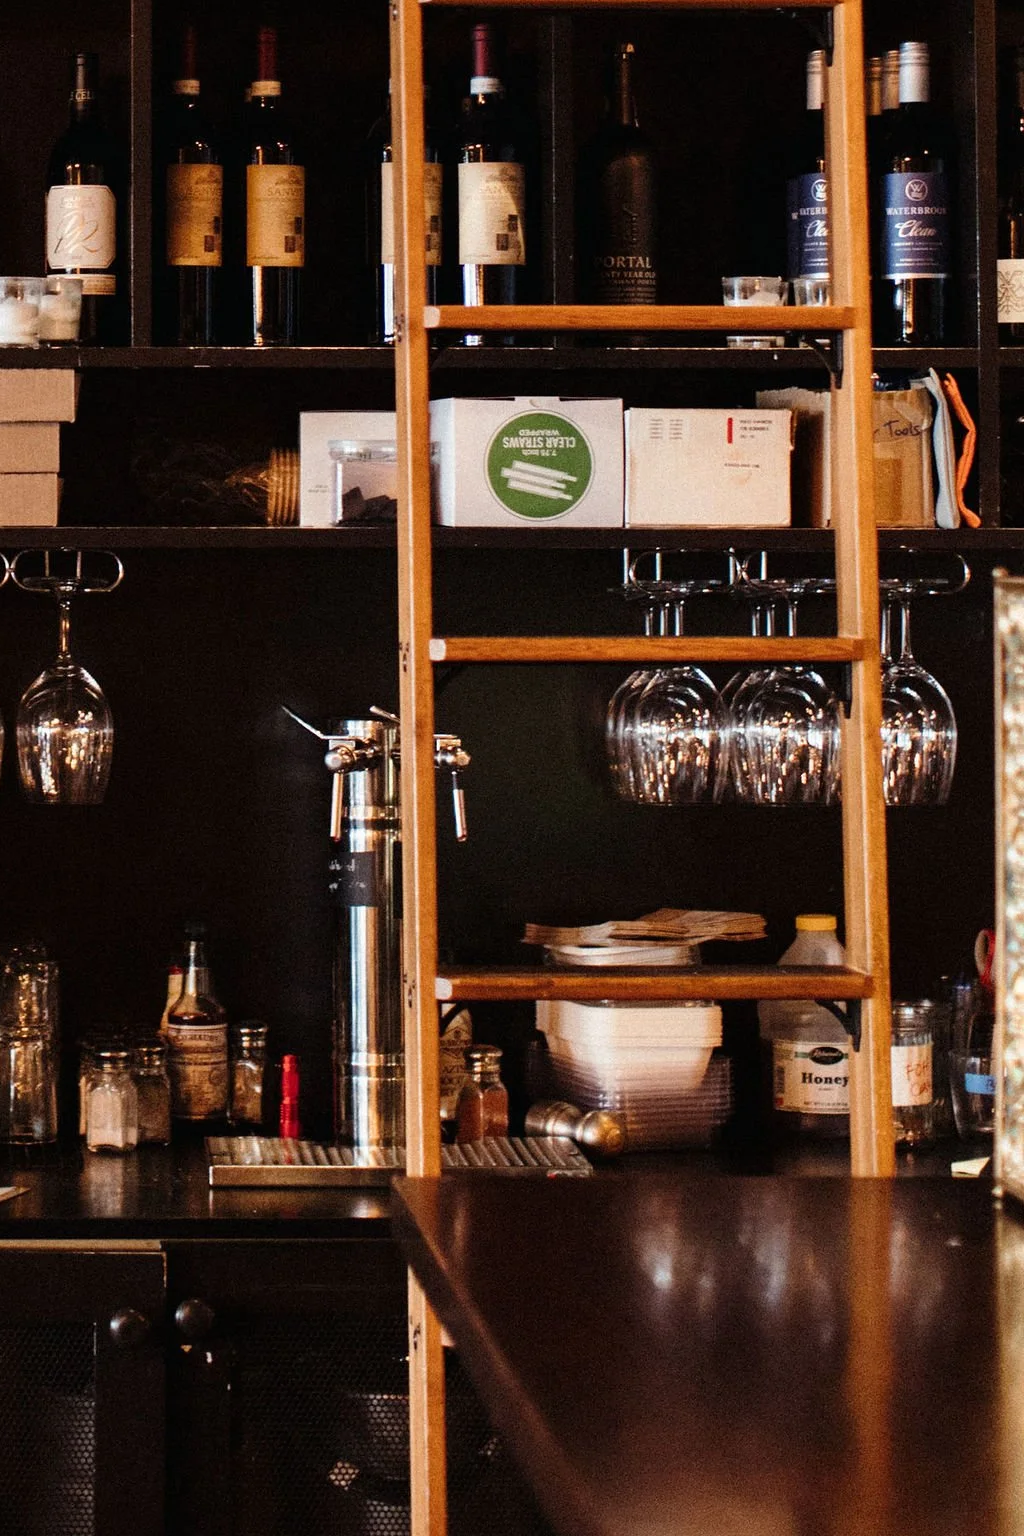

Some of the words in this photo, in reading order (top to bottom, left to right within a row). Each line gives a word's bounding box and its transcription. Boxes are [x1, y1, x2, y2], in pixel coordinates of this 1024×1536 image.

[895, 219, 937, 238] Clean
[518, 428, 561, 437] WRAPPED
[883, 419, 922, 437] Tools
[502, 436, 544, 449] STRAWS
[545, 436, 577, 449] CLEAR
[801, 1071, 849, 1087] Honey
